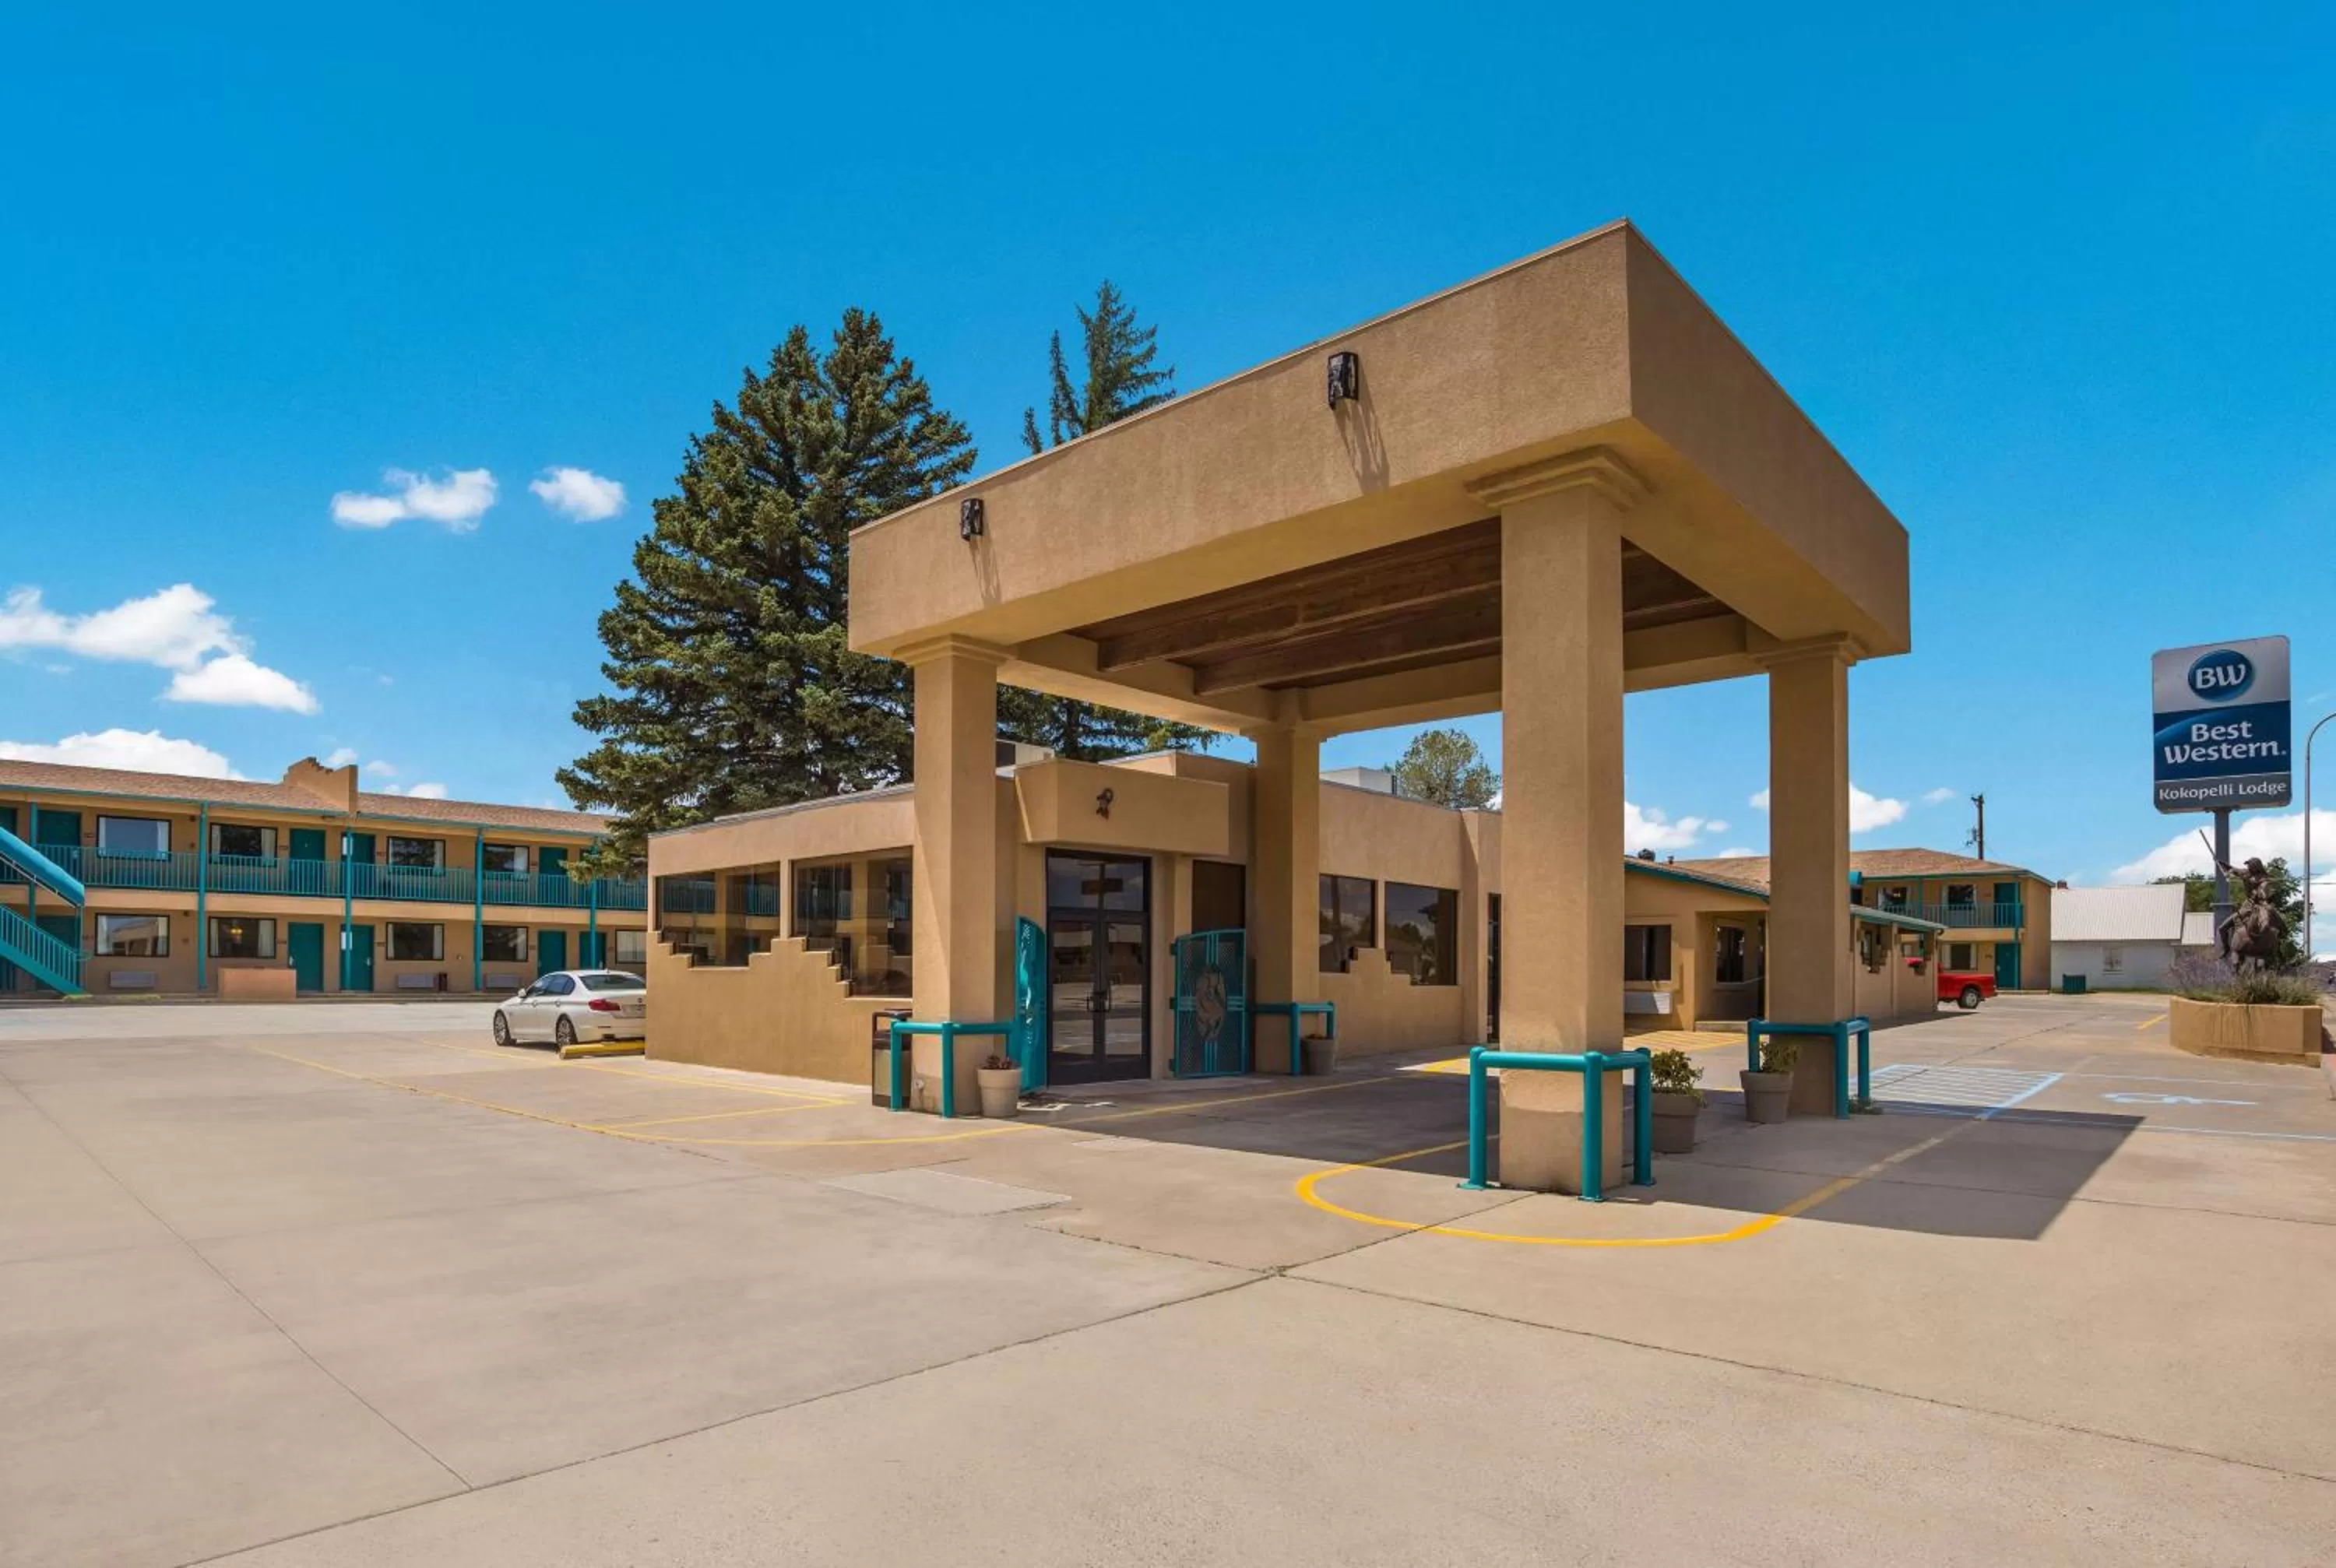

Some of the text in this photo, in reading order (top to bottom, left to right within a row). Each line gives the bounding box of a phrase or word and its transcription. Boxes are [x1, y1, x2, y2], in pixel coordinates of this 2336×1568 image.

[2195, 663, 2247, 690] BW
[2191, 721, 2253, 742] Best
[2158, 781, 2288, 800] Kokopelli Lodge
